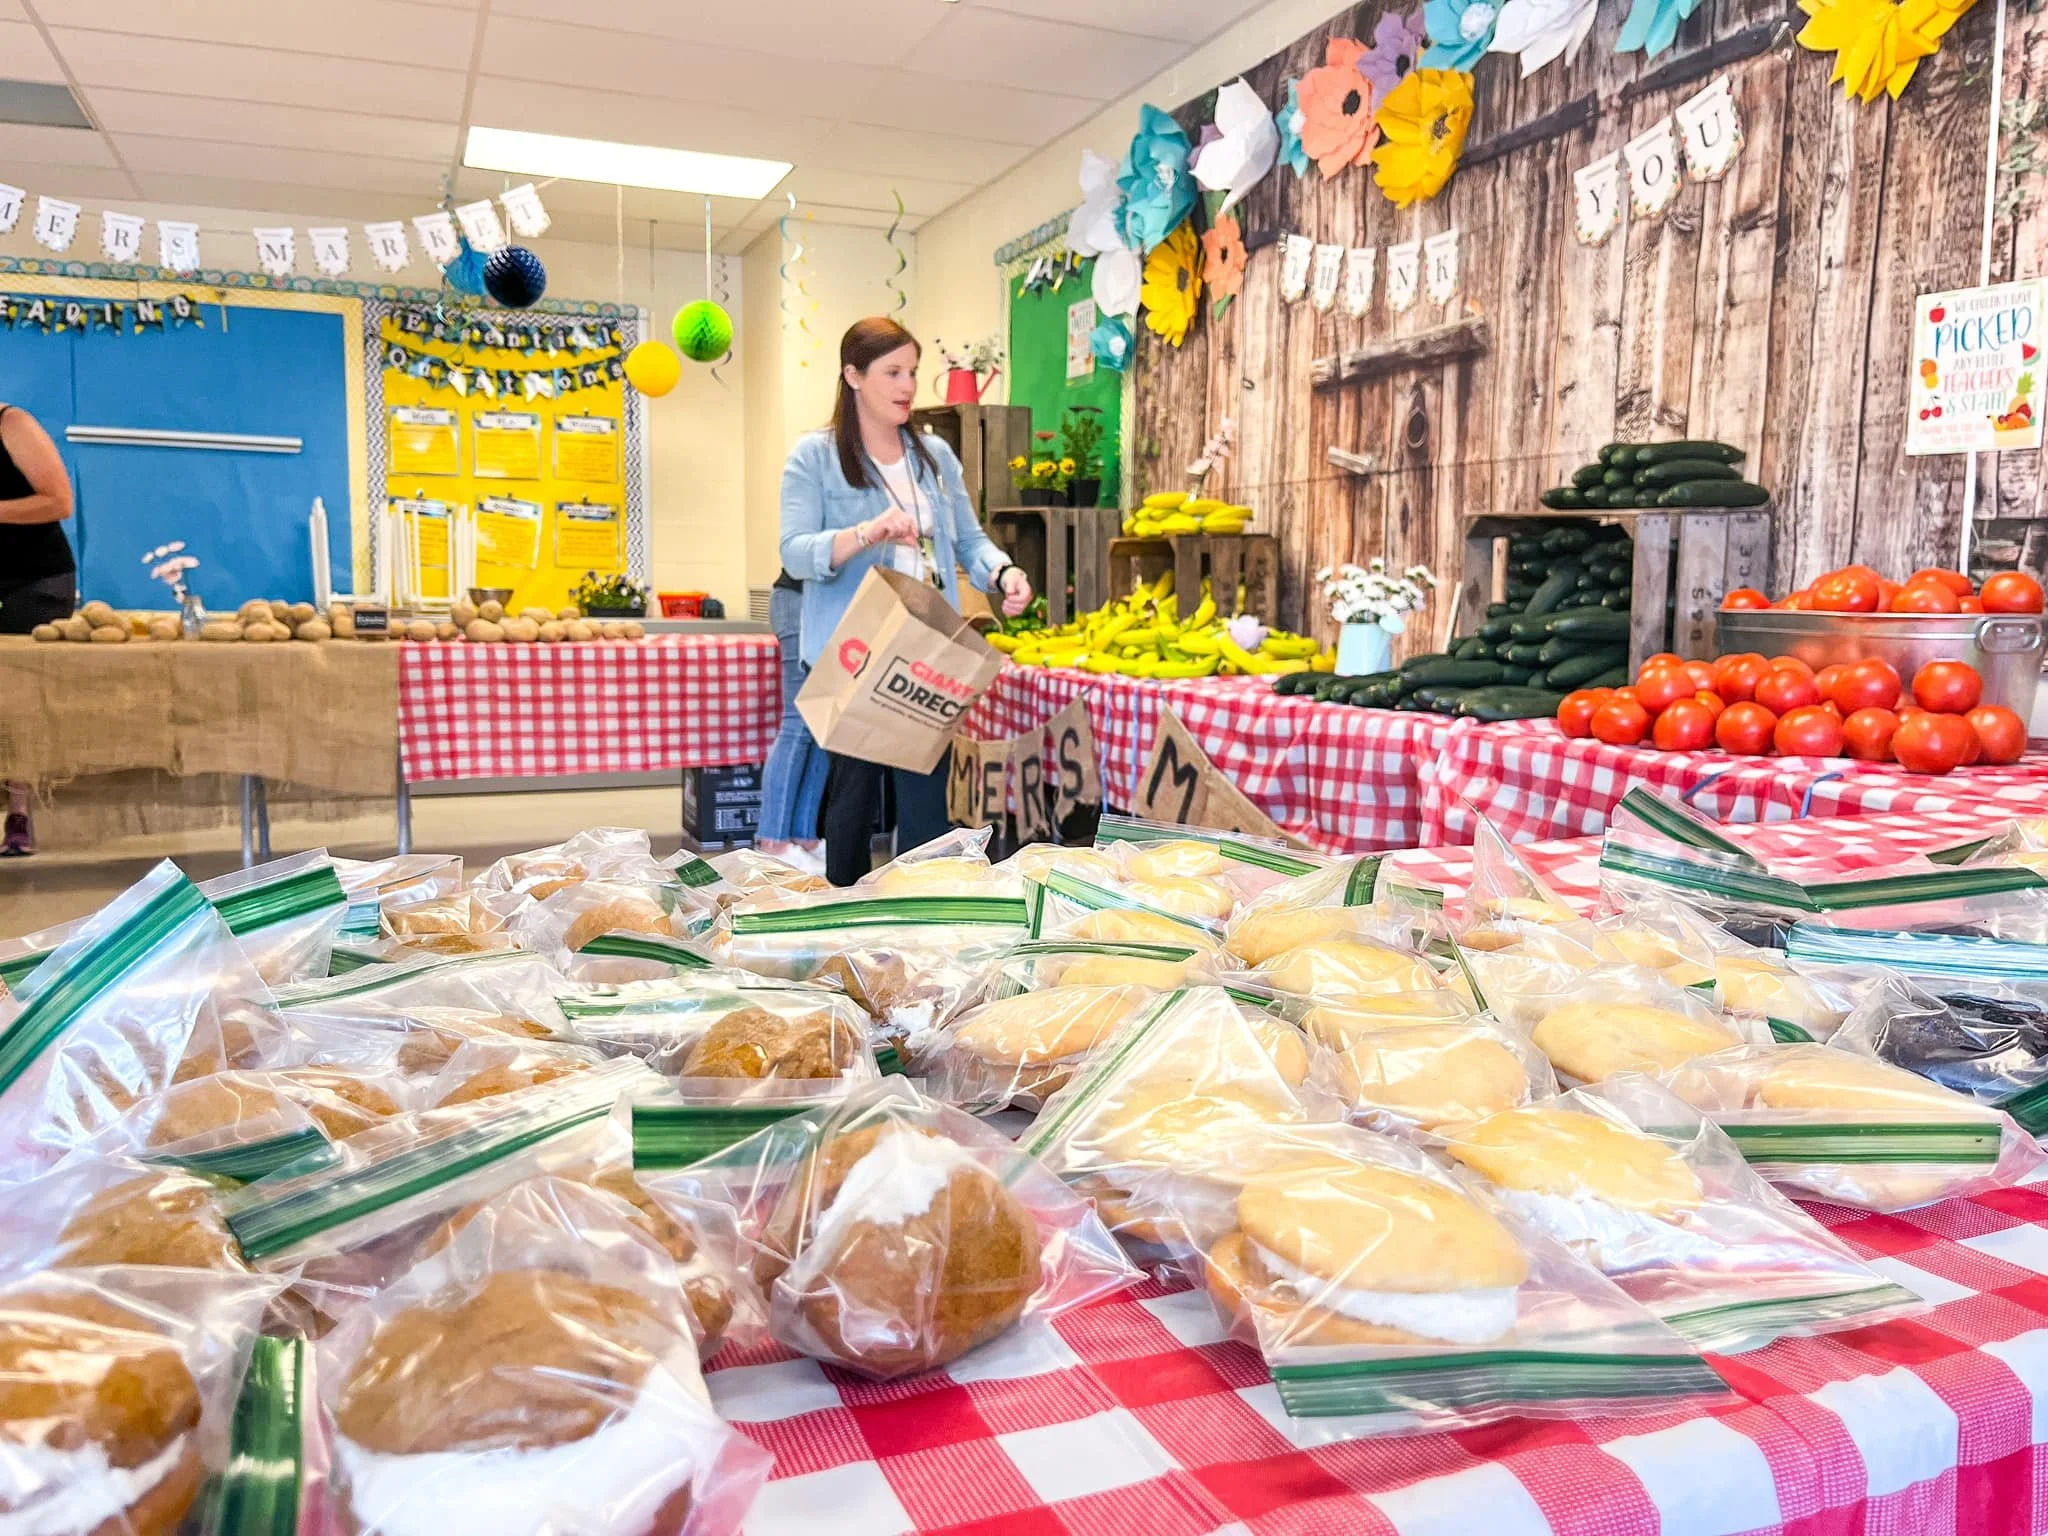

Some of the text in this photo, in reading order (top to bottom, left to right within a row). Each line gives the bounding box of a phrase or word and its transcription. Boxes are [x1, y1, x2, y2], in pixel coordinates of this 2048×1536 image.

[1589, 109, 1722, 215] YOU
[266, 203, 533, 263] MARKET
[1290, 254, 1450, 295] THANK
[1942, 367, 2015, 393] TEACHERS
[909, 660, 977, 700] GIANT
[950, 727, 1085, 826] MERS
